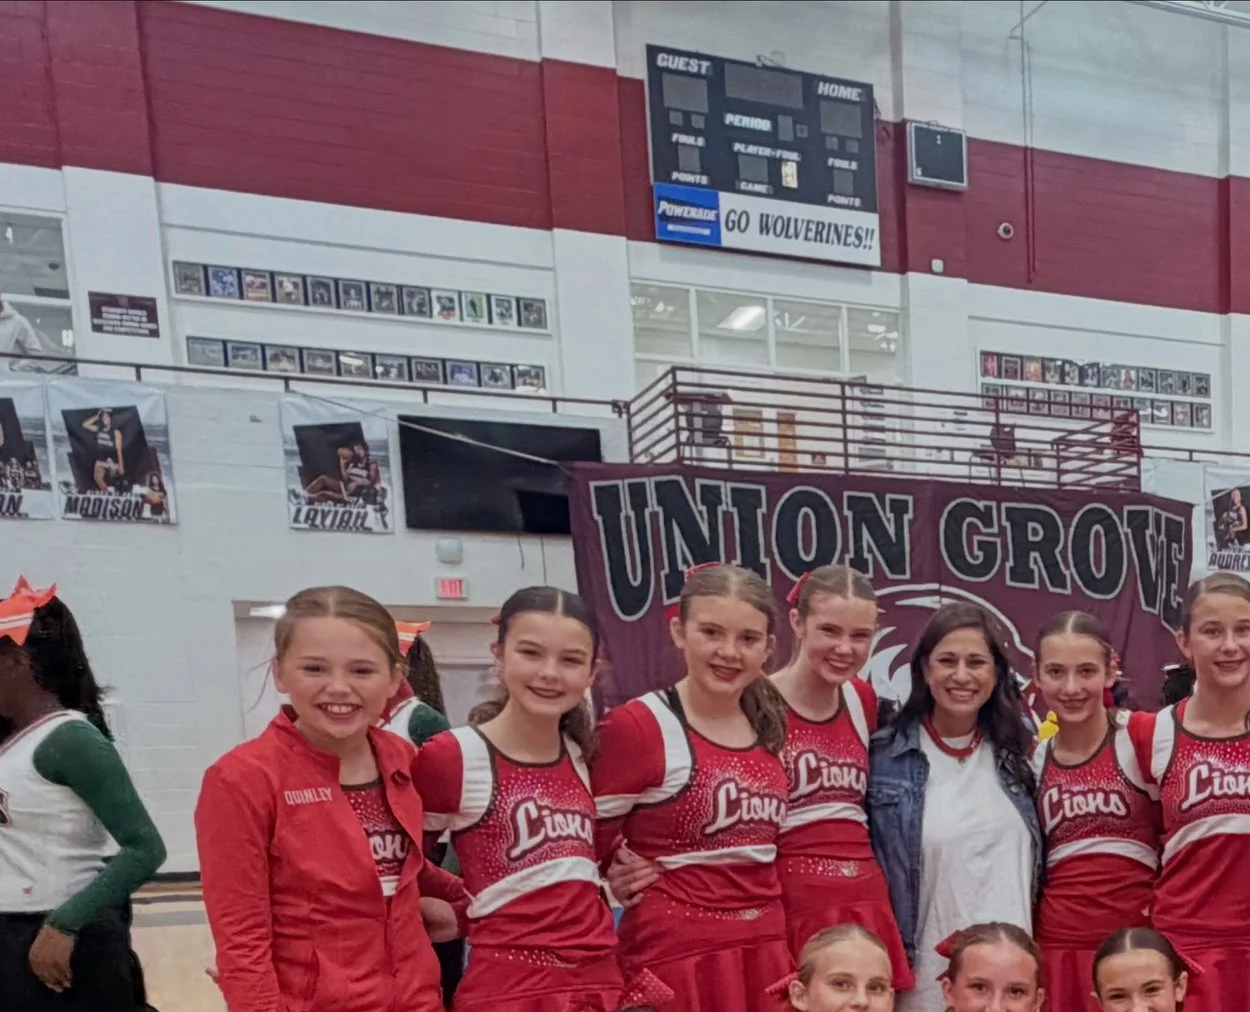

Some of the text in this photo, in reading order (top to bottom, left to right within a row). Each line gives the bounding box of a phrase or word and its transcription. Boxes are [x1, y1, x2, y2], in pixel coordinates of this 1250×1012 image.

[657, 53, 712, 75] GUEST
[817, 81, 863, 101] HOME
[724, 112, 773, 132] PERIOD
[672, 133, 705, 147] FOULS
[827, 157, 858, 171] FOULS
[671, 172, 709, 185] POINTS
[740, 181, 770, 194] GAME
[827, 194, 861, 207] POINTS
[724, 208, 875, 250] GO WOLVERINES!!
[64, 495, 145, 521] MADISON
[589, 475, 1187, 634] UNION GROVE
[788, 752, 867, 801] Lions
[284, 787, 333, 806] QUINLEY
[704, 781, 787, 835] Lions
[1043, 786, 1127, 837] Lions
